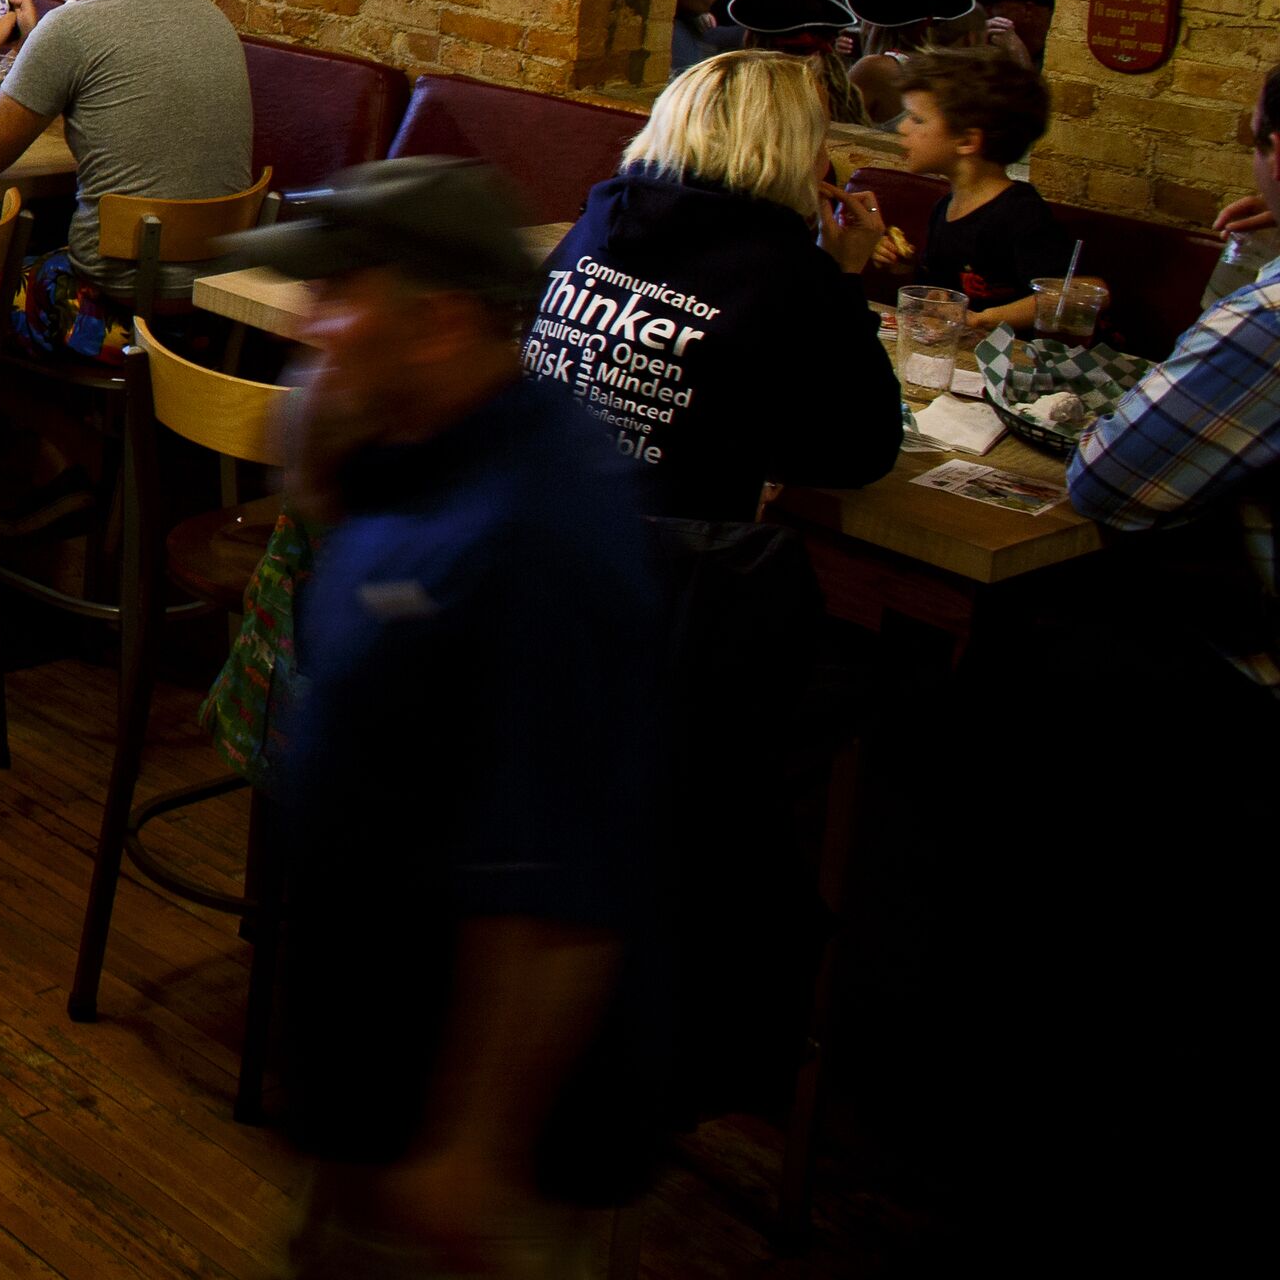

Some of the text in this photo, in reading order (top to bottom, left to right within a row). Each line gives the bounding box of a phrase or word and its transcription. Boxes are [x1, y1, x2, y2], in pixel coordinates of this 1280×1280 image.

[576, 256, 721, 321] Communicator
[540, 270, 705, 357] Thinker
[524, 339, 574, 383] Risk
[612, 342, 683, 382] Open
[590, 386, 674, 424] Balanced
[596, 362, 692, 408] Minded
